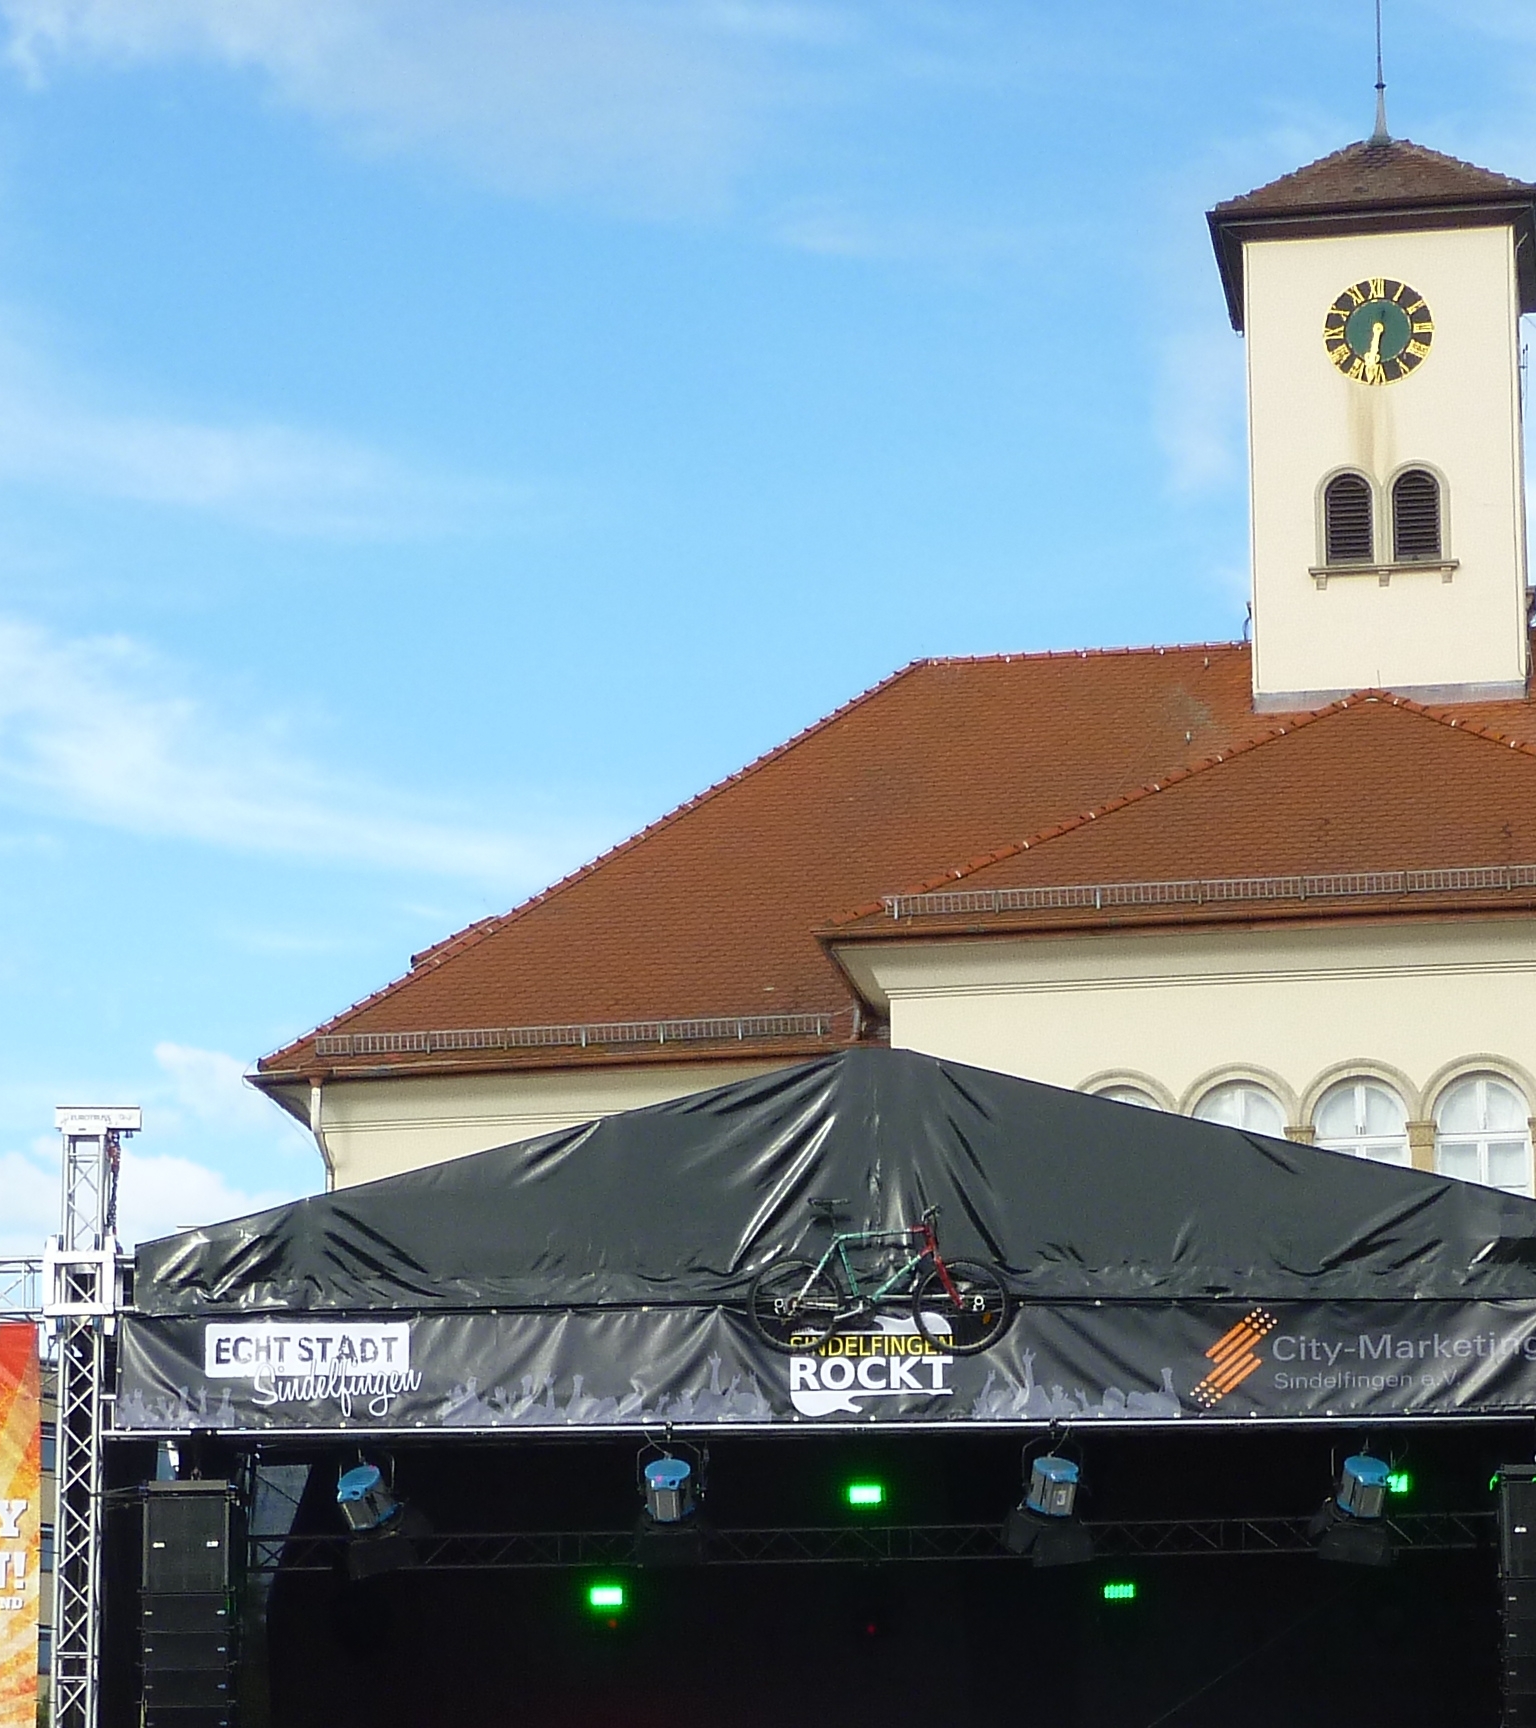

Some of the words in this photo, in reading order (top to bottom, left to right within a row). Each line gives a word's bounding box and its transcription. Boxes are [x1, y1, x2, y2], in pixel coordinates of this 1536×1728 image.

[215, 1336, 291, 1365] ECHT
[297, 1335, 399, 1365] STADT
[252, 1358, 422, 1417] Sindelfingen
[790, 1356, 953, 1390] ROCKT
[1274, 1371, 1413, 1391] Sindelfingen
